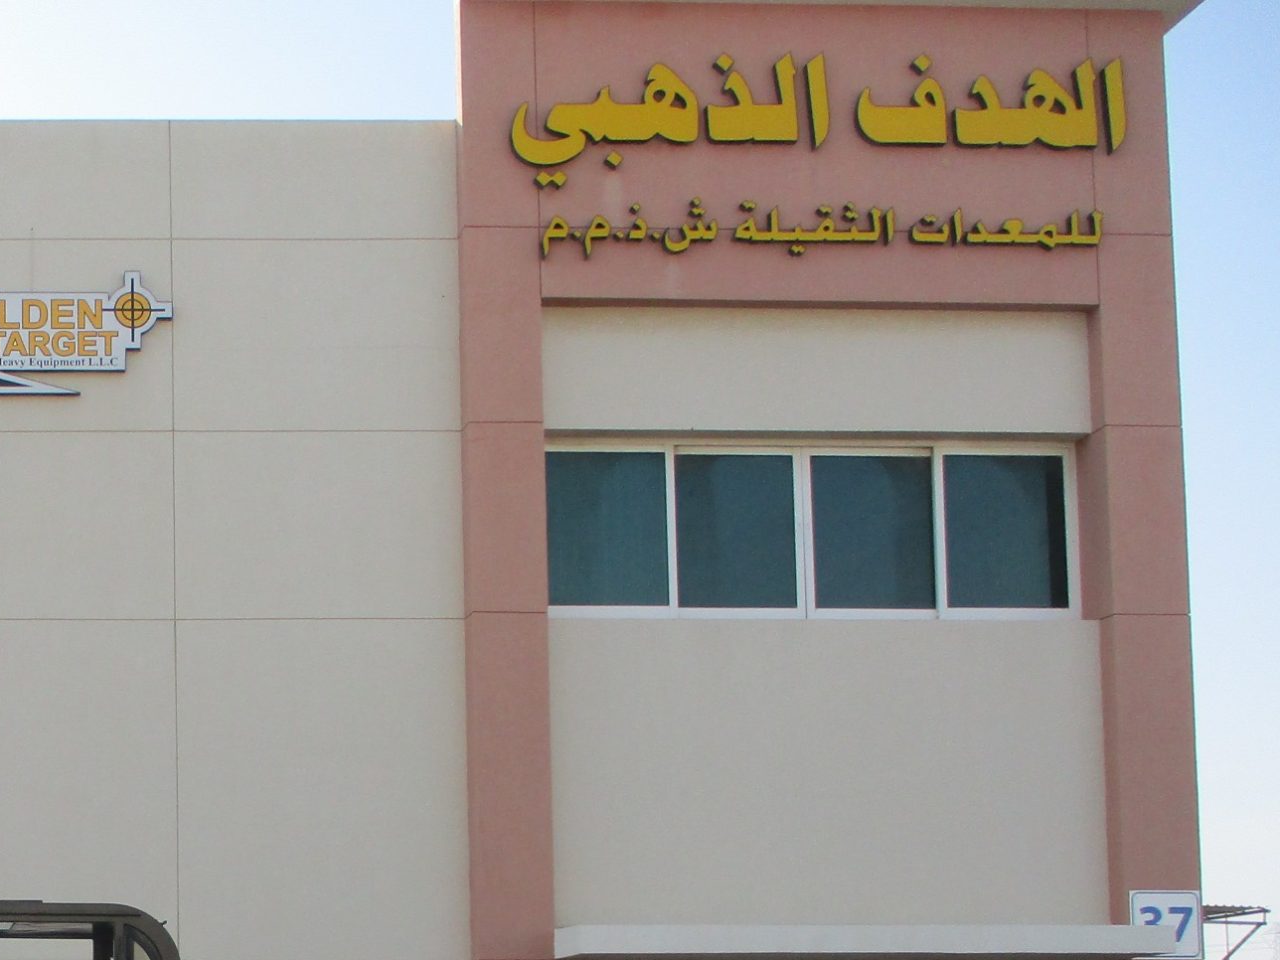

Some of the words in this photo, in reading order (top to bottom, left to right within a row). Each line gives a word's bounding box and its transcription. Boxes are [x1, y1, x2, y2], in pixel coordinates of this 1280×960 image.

[510, 53, 830, 189] الذهبي
[857, 54, 1128, 155] الهدف
[733, 200, 895, 257] الثقيلة
[910, 207, 1104, 249] للمعدات
[29, 356, 86, 369] Equipment
[88, 356, 119, 368] L.L.C
